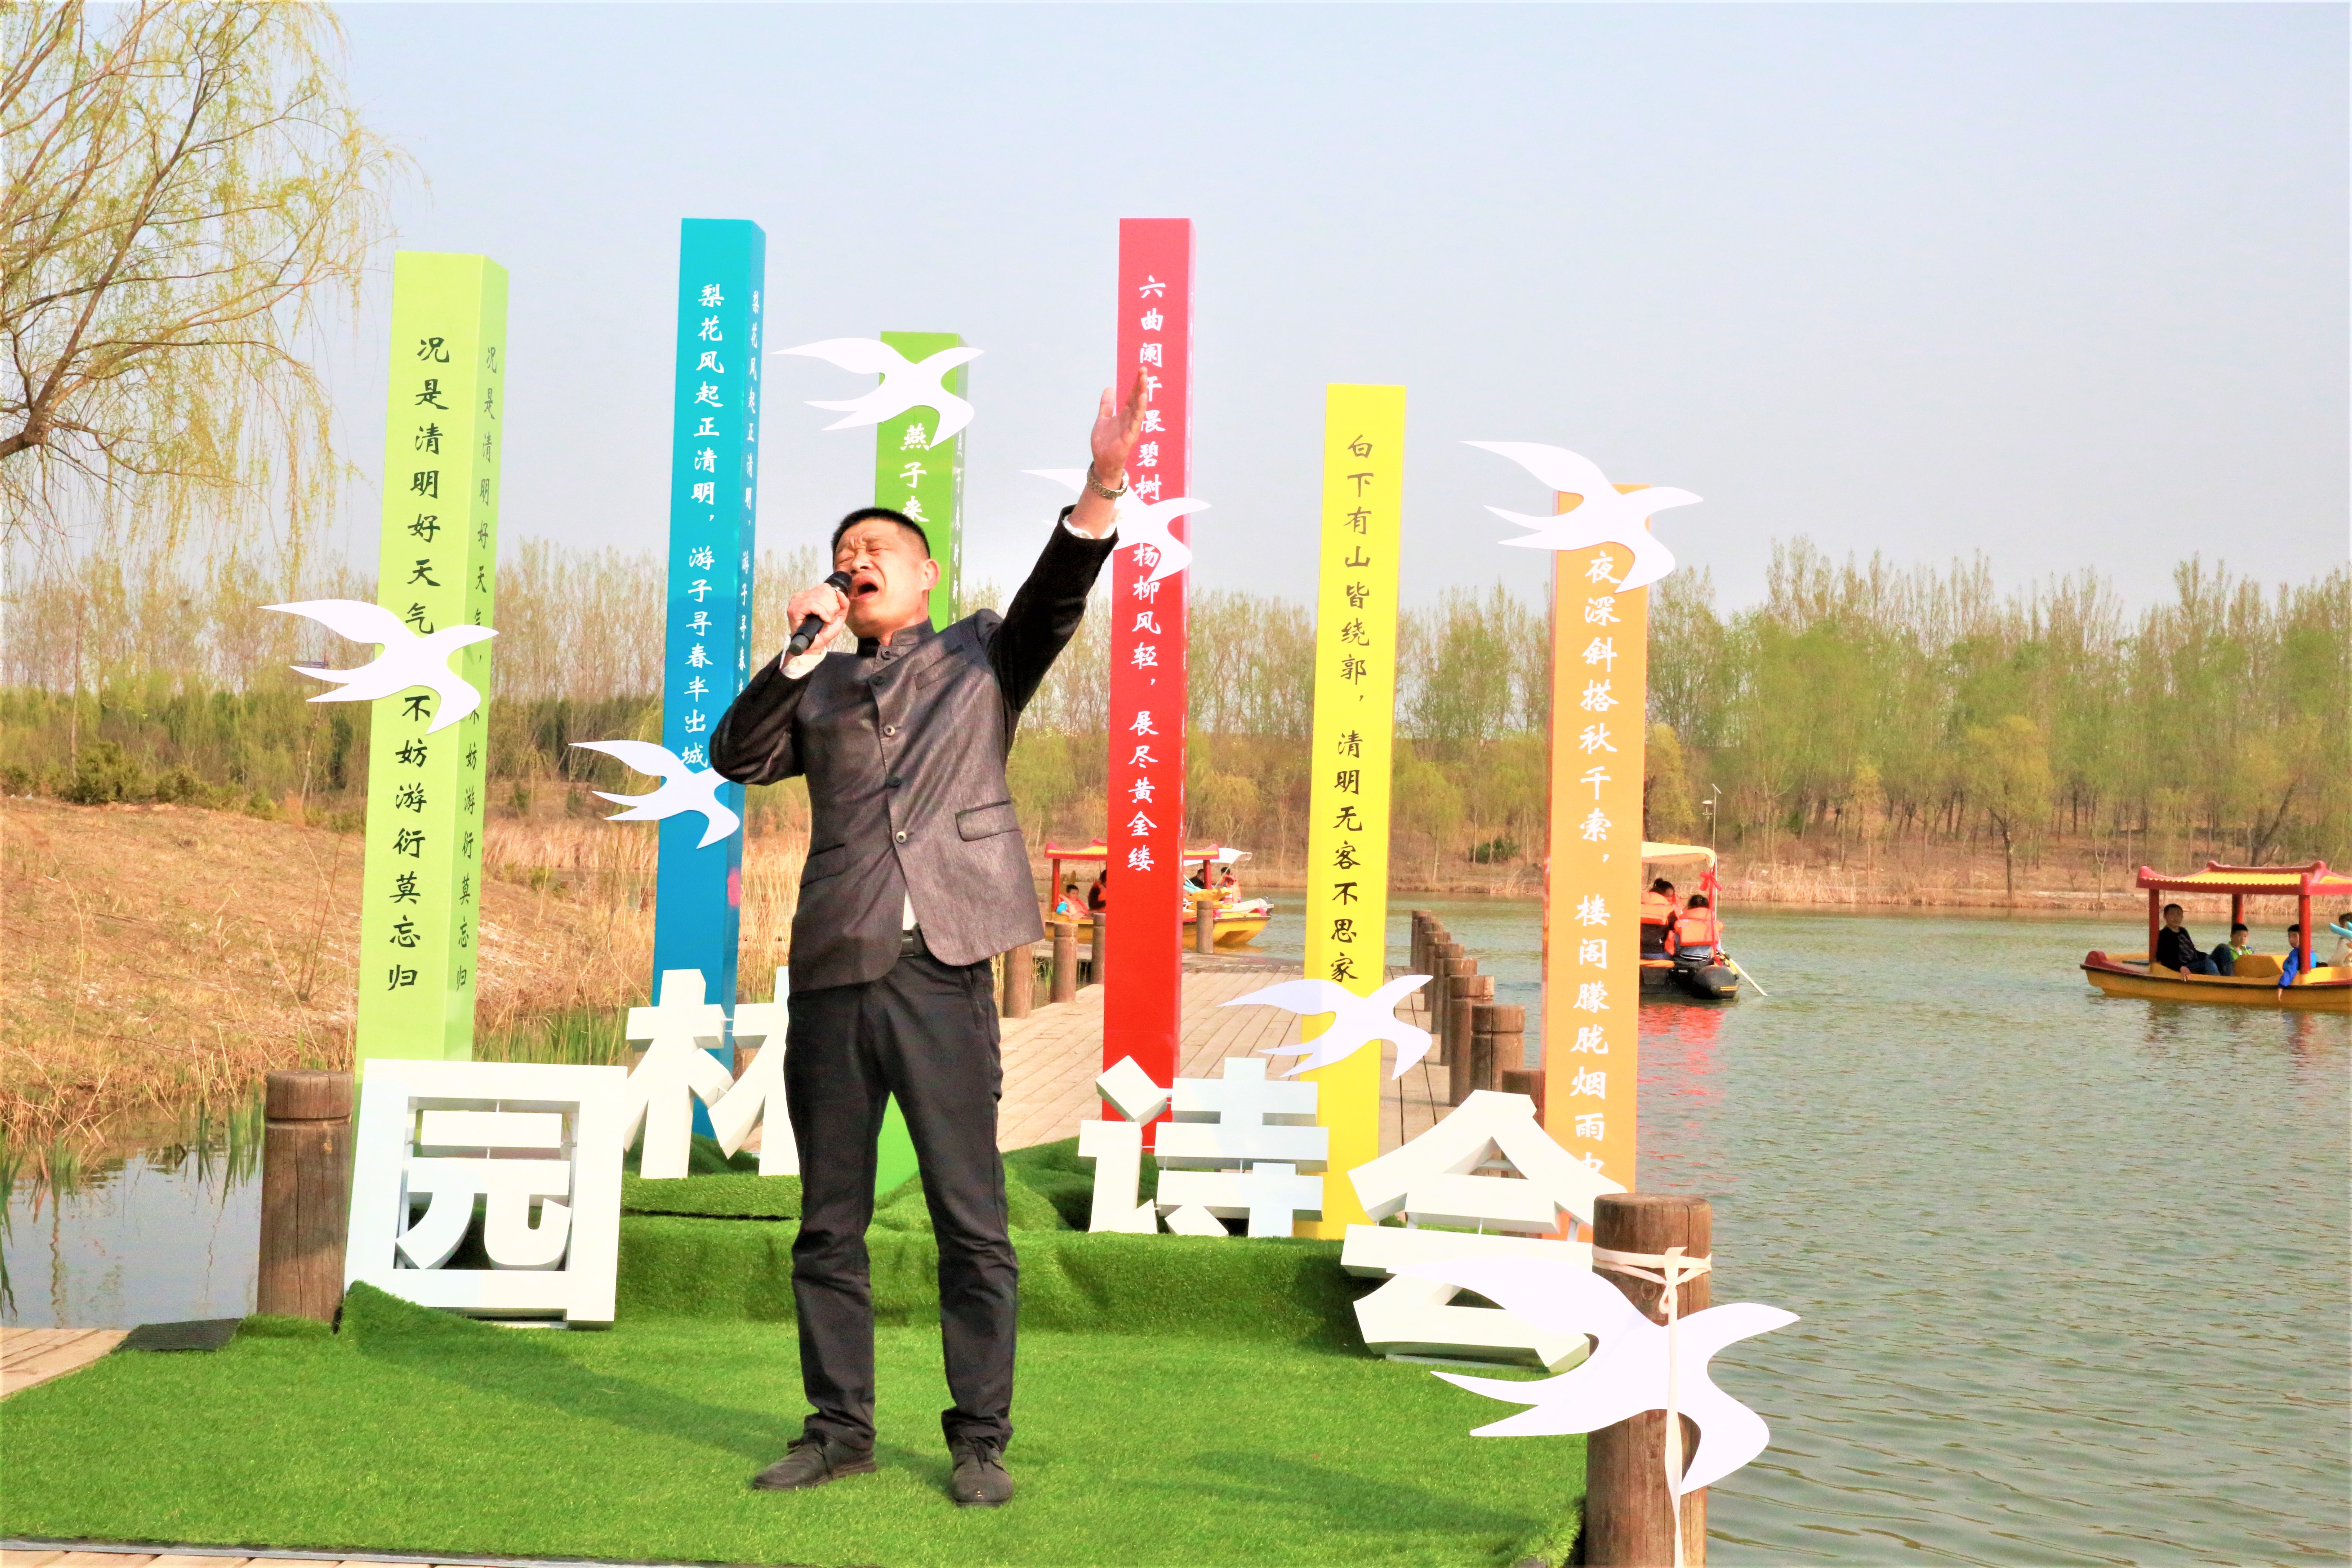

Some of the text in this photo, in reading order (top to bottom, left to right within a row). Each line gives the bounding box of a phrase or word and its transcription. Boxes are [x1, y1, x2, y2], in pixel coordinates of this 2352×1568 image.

[388, 337, 449, 991] 况是清明好天气不妨游衍莫忘归
[1126, 275, 1166, 872] 六曲阑干偎碧树杨柳风轻，展尽黄金缕
